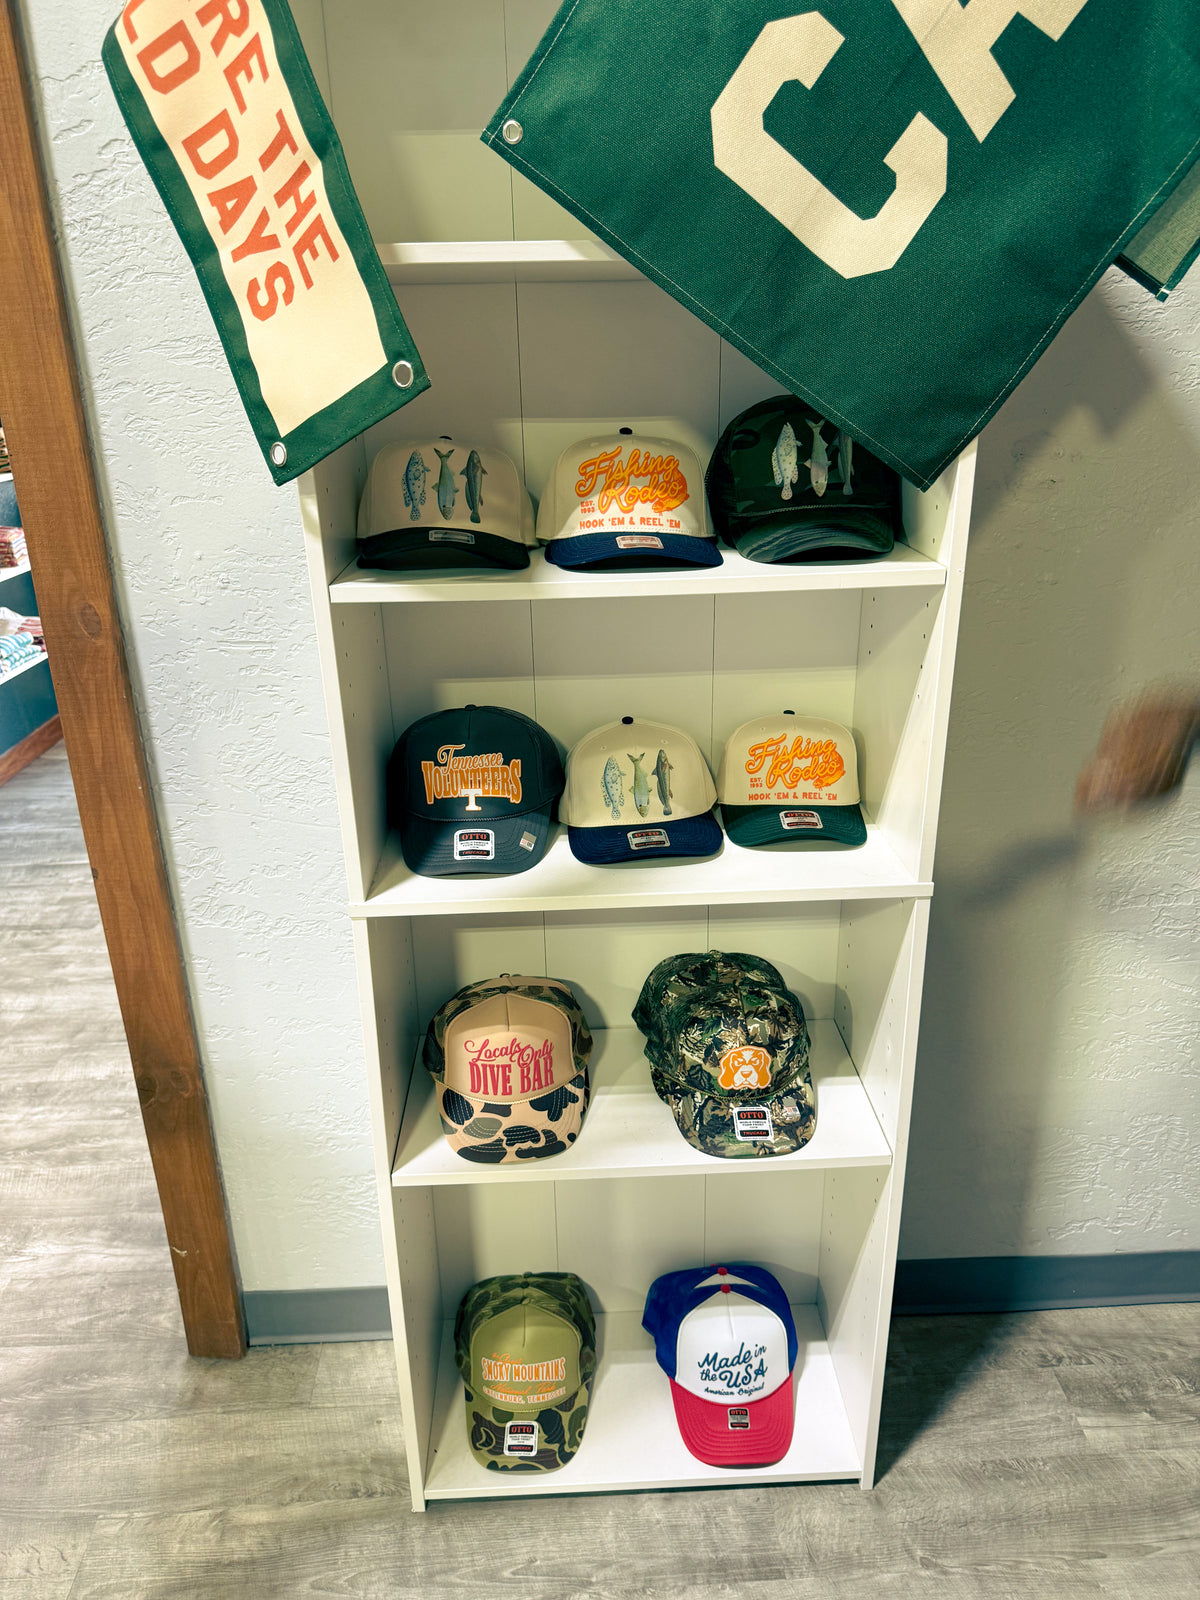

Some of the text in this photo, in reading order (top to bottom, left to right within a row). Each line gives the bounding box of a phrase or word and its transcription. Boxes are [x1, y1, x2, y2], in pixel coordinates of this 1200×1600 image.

[181, 107, 296, 322] DAYS
[258, 108, 340, 291] THE
[575, 445, 680, 498] Fishing
[598, 474, 684, 514] Rodeo
[579, 518, 605, 530] HOOK
[628, 516, 636, 526] &
[639, 516, 664, 527] REEL
[437, 743, 504, 775] Tennessee
[745, 732, 838, 775] Fishing
[421, 758, 523, 805] VOLUNTEERS
[766, 755, 840, 790] Rodeo
[748, 793, 771, 801] HOOK
[792, 792, 799, 800] &
[802, 792, 823, 800] REEL
[461, 832, 487, 841] OTTO
[464, 1037, 555, 1068] Locals Only
[468, 1056, 555, 1096] DIVE BAR
[739, 1111, 764, 1120] OTTO
[481, 1356, 566, 1382] SMOKY MOUNTAINS
[697, 1342, 767, 1372] Made in
[699, 1358, 768, 1389] the USA
[704, 1381, 765, 1397] American Original
[526, 1386, 566, 1404] TENNESSEE
[510, 1425, 533, 1434] OTTO
